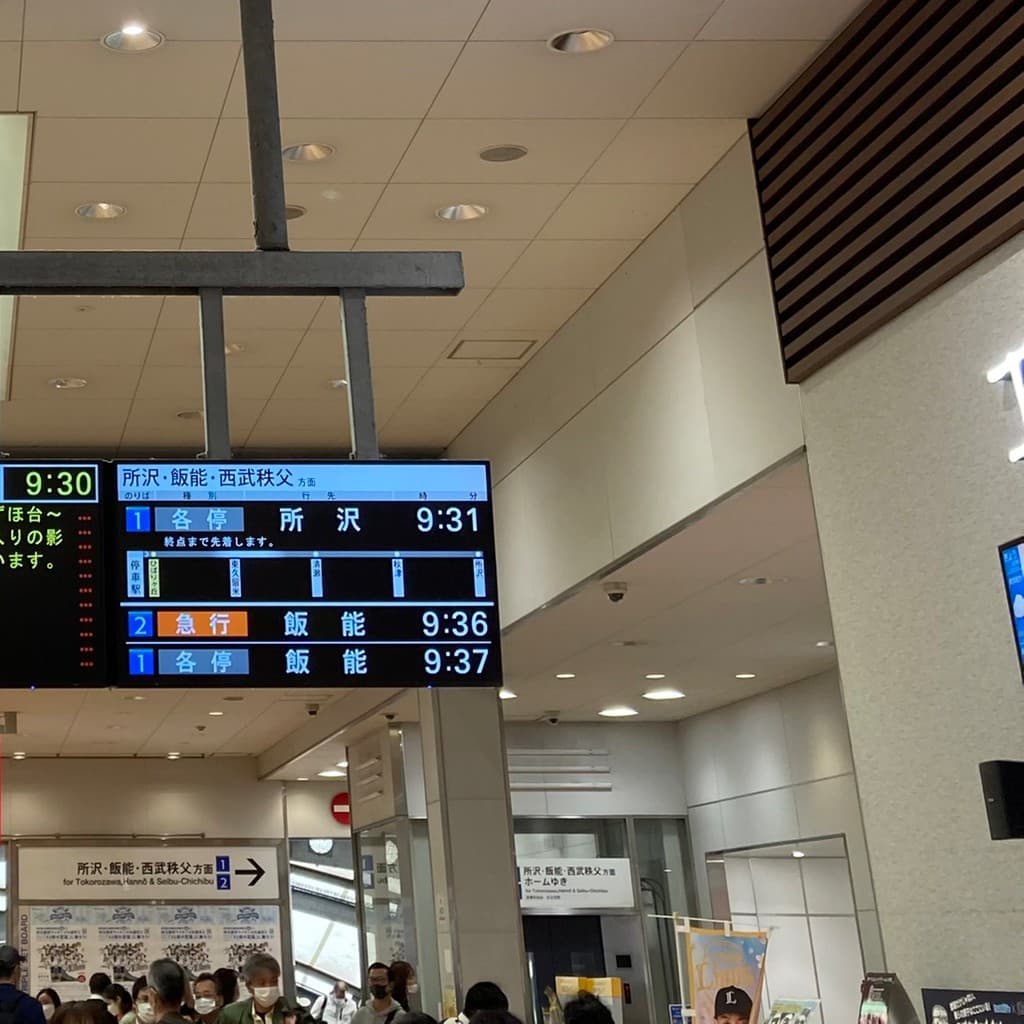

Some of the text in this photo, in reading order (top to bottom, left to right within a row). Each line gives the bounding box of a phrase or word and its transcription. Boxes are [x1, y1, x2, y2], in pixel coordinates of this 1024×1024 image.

[25, 471, 93, 496] 9:30
[125, 491, 150, 500] のりば
[134, 511, 141, 530] 1
[416, 507, 478, 532] 9:31
[164, 536, 274, 548] 終点まで先着します。
[130, 560, 141, 594] 停車駅
[134, 617, 147, 635] 2
[422, 611, 489, 637] 9:36
[137, 654, 145, 673] 1
[423, 648, 490, 675] 9:37
[220, 859, 225, 870] 1
[63, 878, 74, 886] for
[149, 878, 155, 886] &
[156, 878, 215, 886] Seibu-Chichibu
[220, 878, 228, 888] 2
